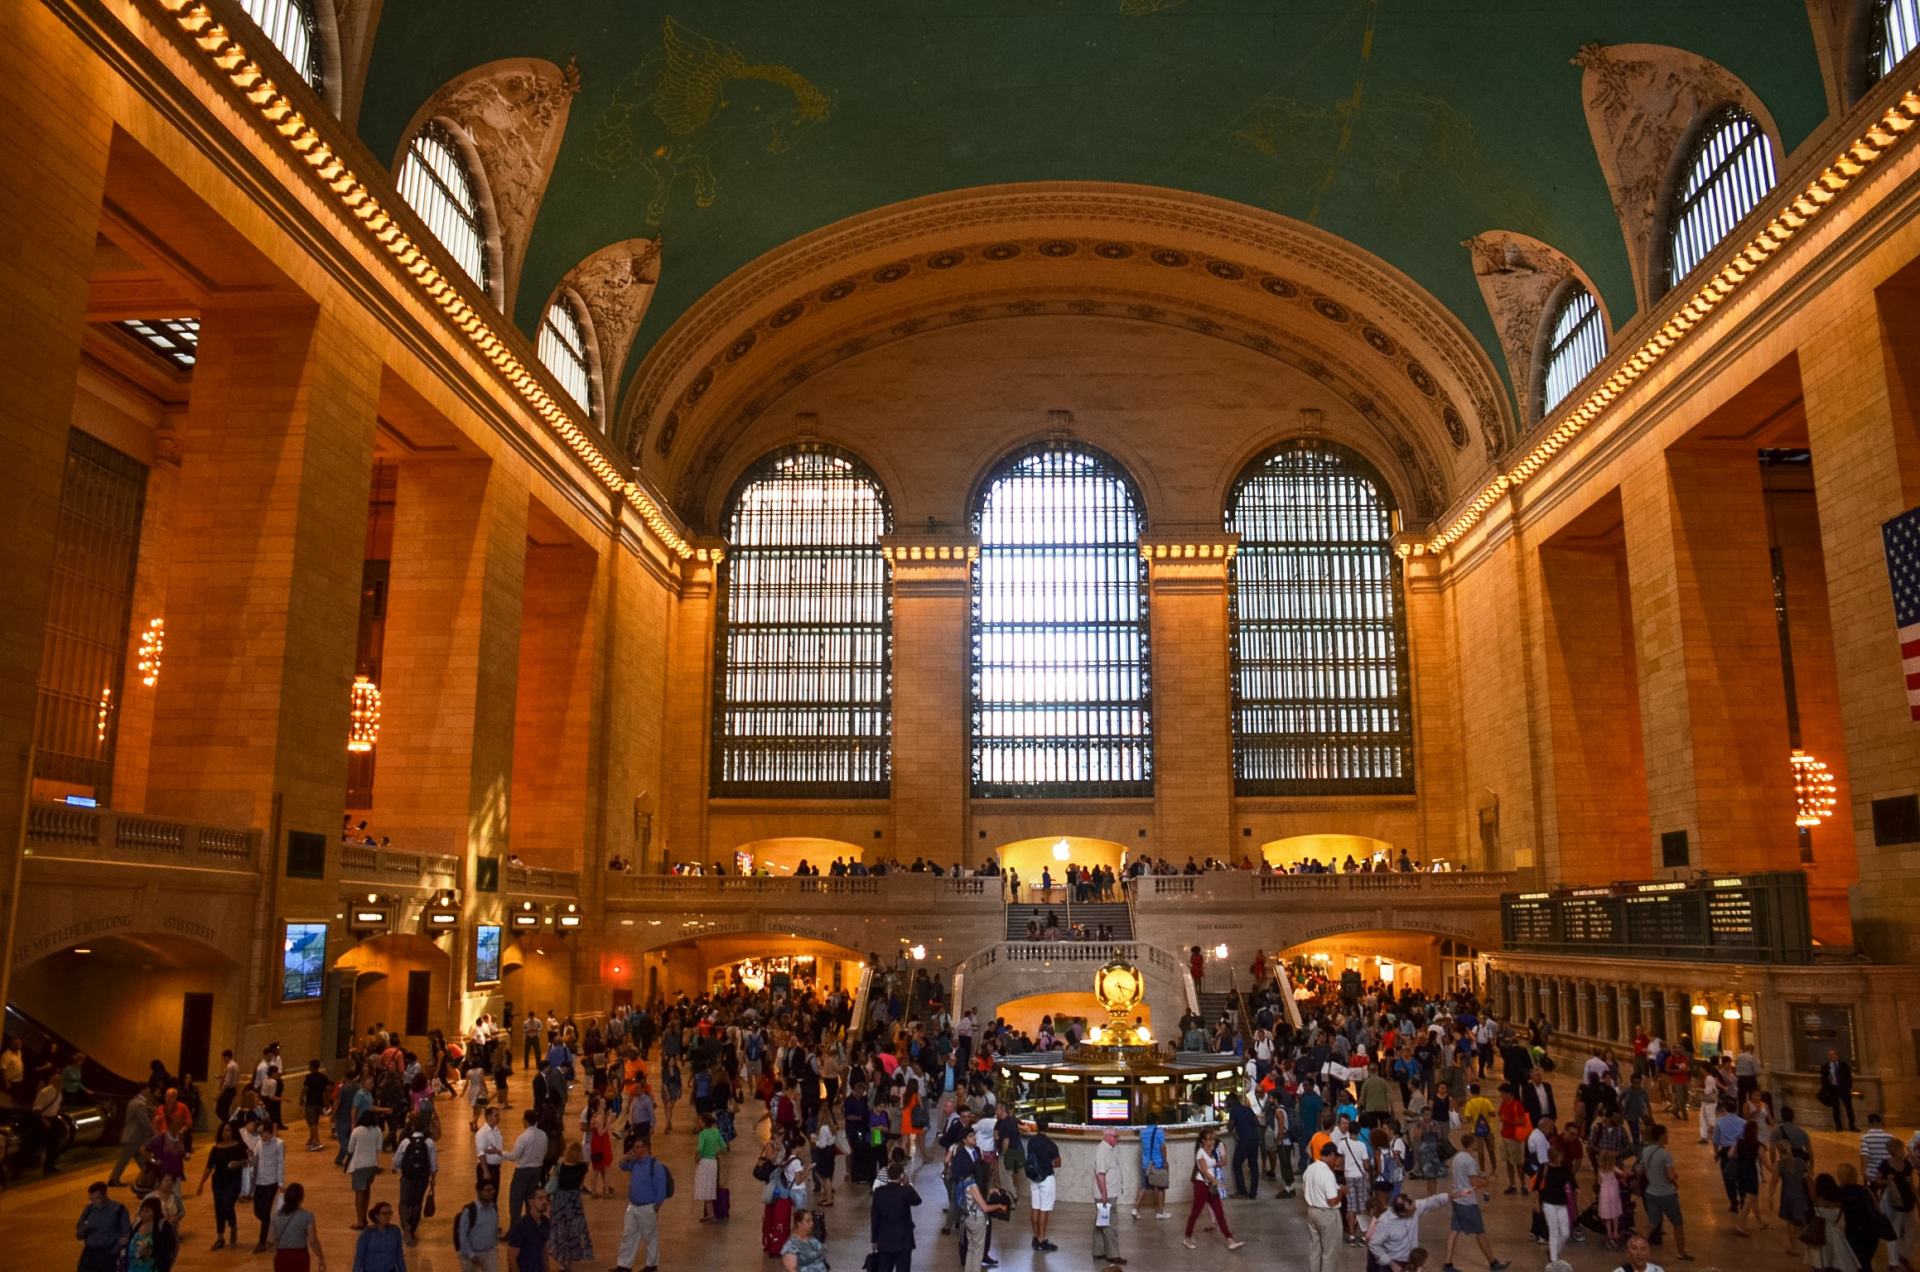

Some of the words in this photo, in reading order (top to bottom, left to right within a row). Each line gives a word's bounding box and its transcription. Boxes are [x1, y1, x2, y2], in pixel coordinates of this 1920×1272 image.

[84, 914, 131, 934] BUILDING
[768, 923, 817, 937] LEXINGTON
[1305, 922, 1354, 939] LEXINGTON
